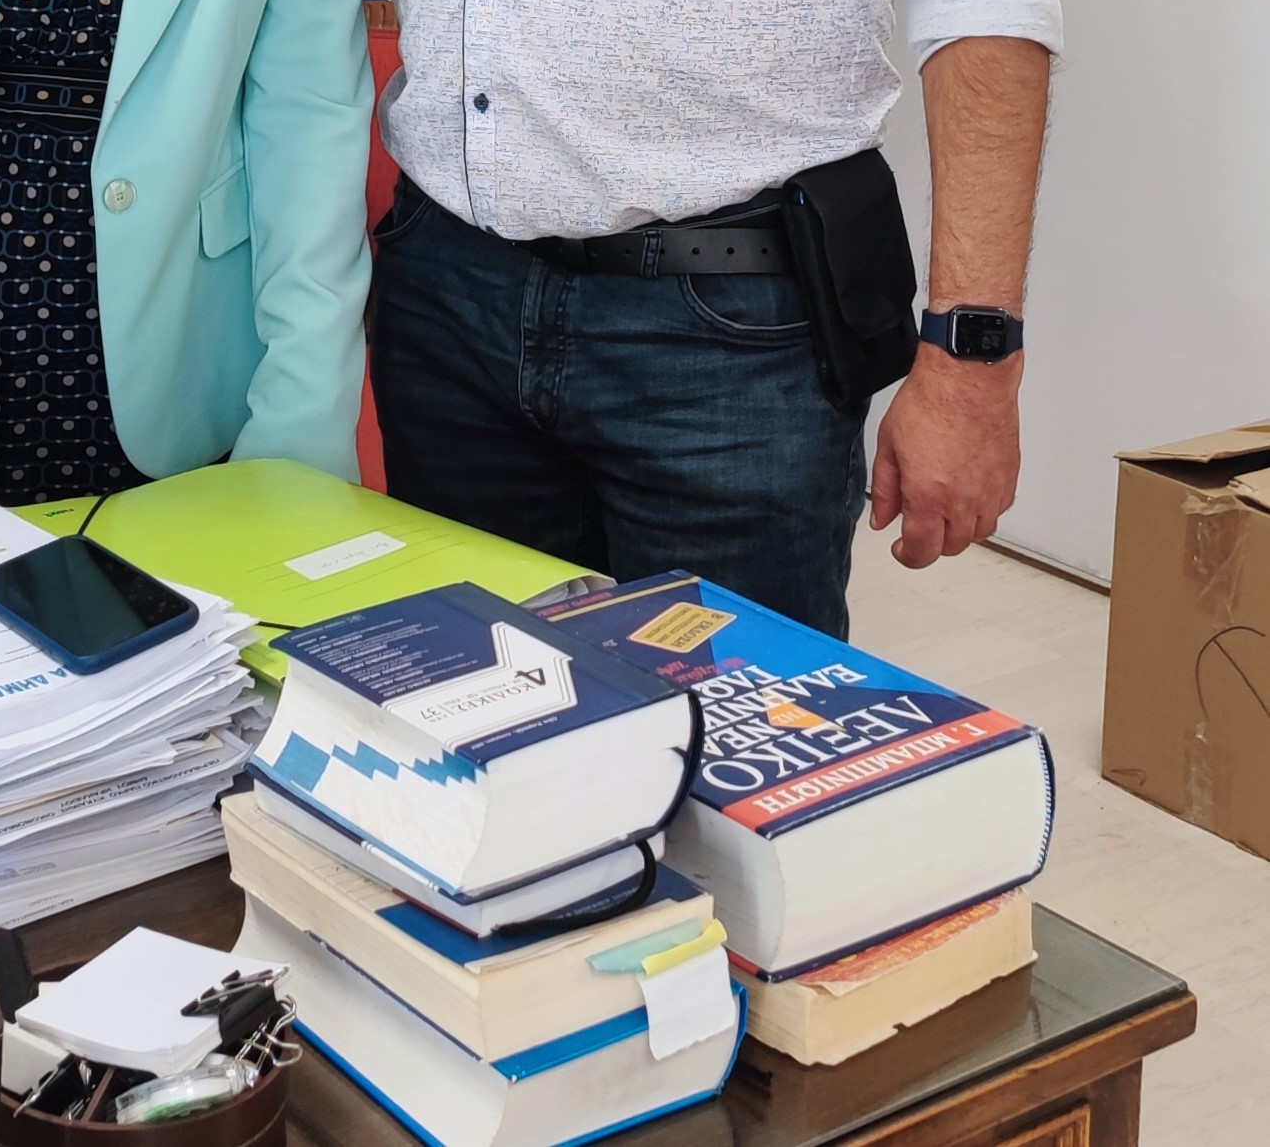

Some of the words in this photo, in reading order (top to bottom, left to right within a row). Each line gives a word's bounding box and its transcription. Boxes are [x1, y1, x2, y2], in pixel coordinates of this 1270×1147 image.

[451, 682, 537, 713] ΚΩΔΙΚΕΣ
[514, 667, 546, 686] 4
[703, 663, 869, 733] ΕΛΛΗΝΙΚ
[701, 695, 933, 792] ΛΕΞΙΚΟ
[702, 716, 786, 757] ΝΕΑ
[752, 734, 961, 816] ΜΠΑΜΠΙΝΙΩΤΗ
